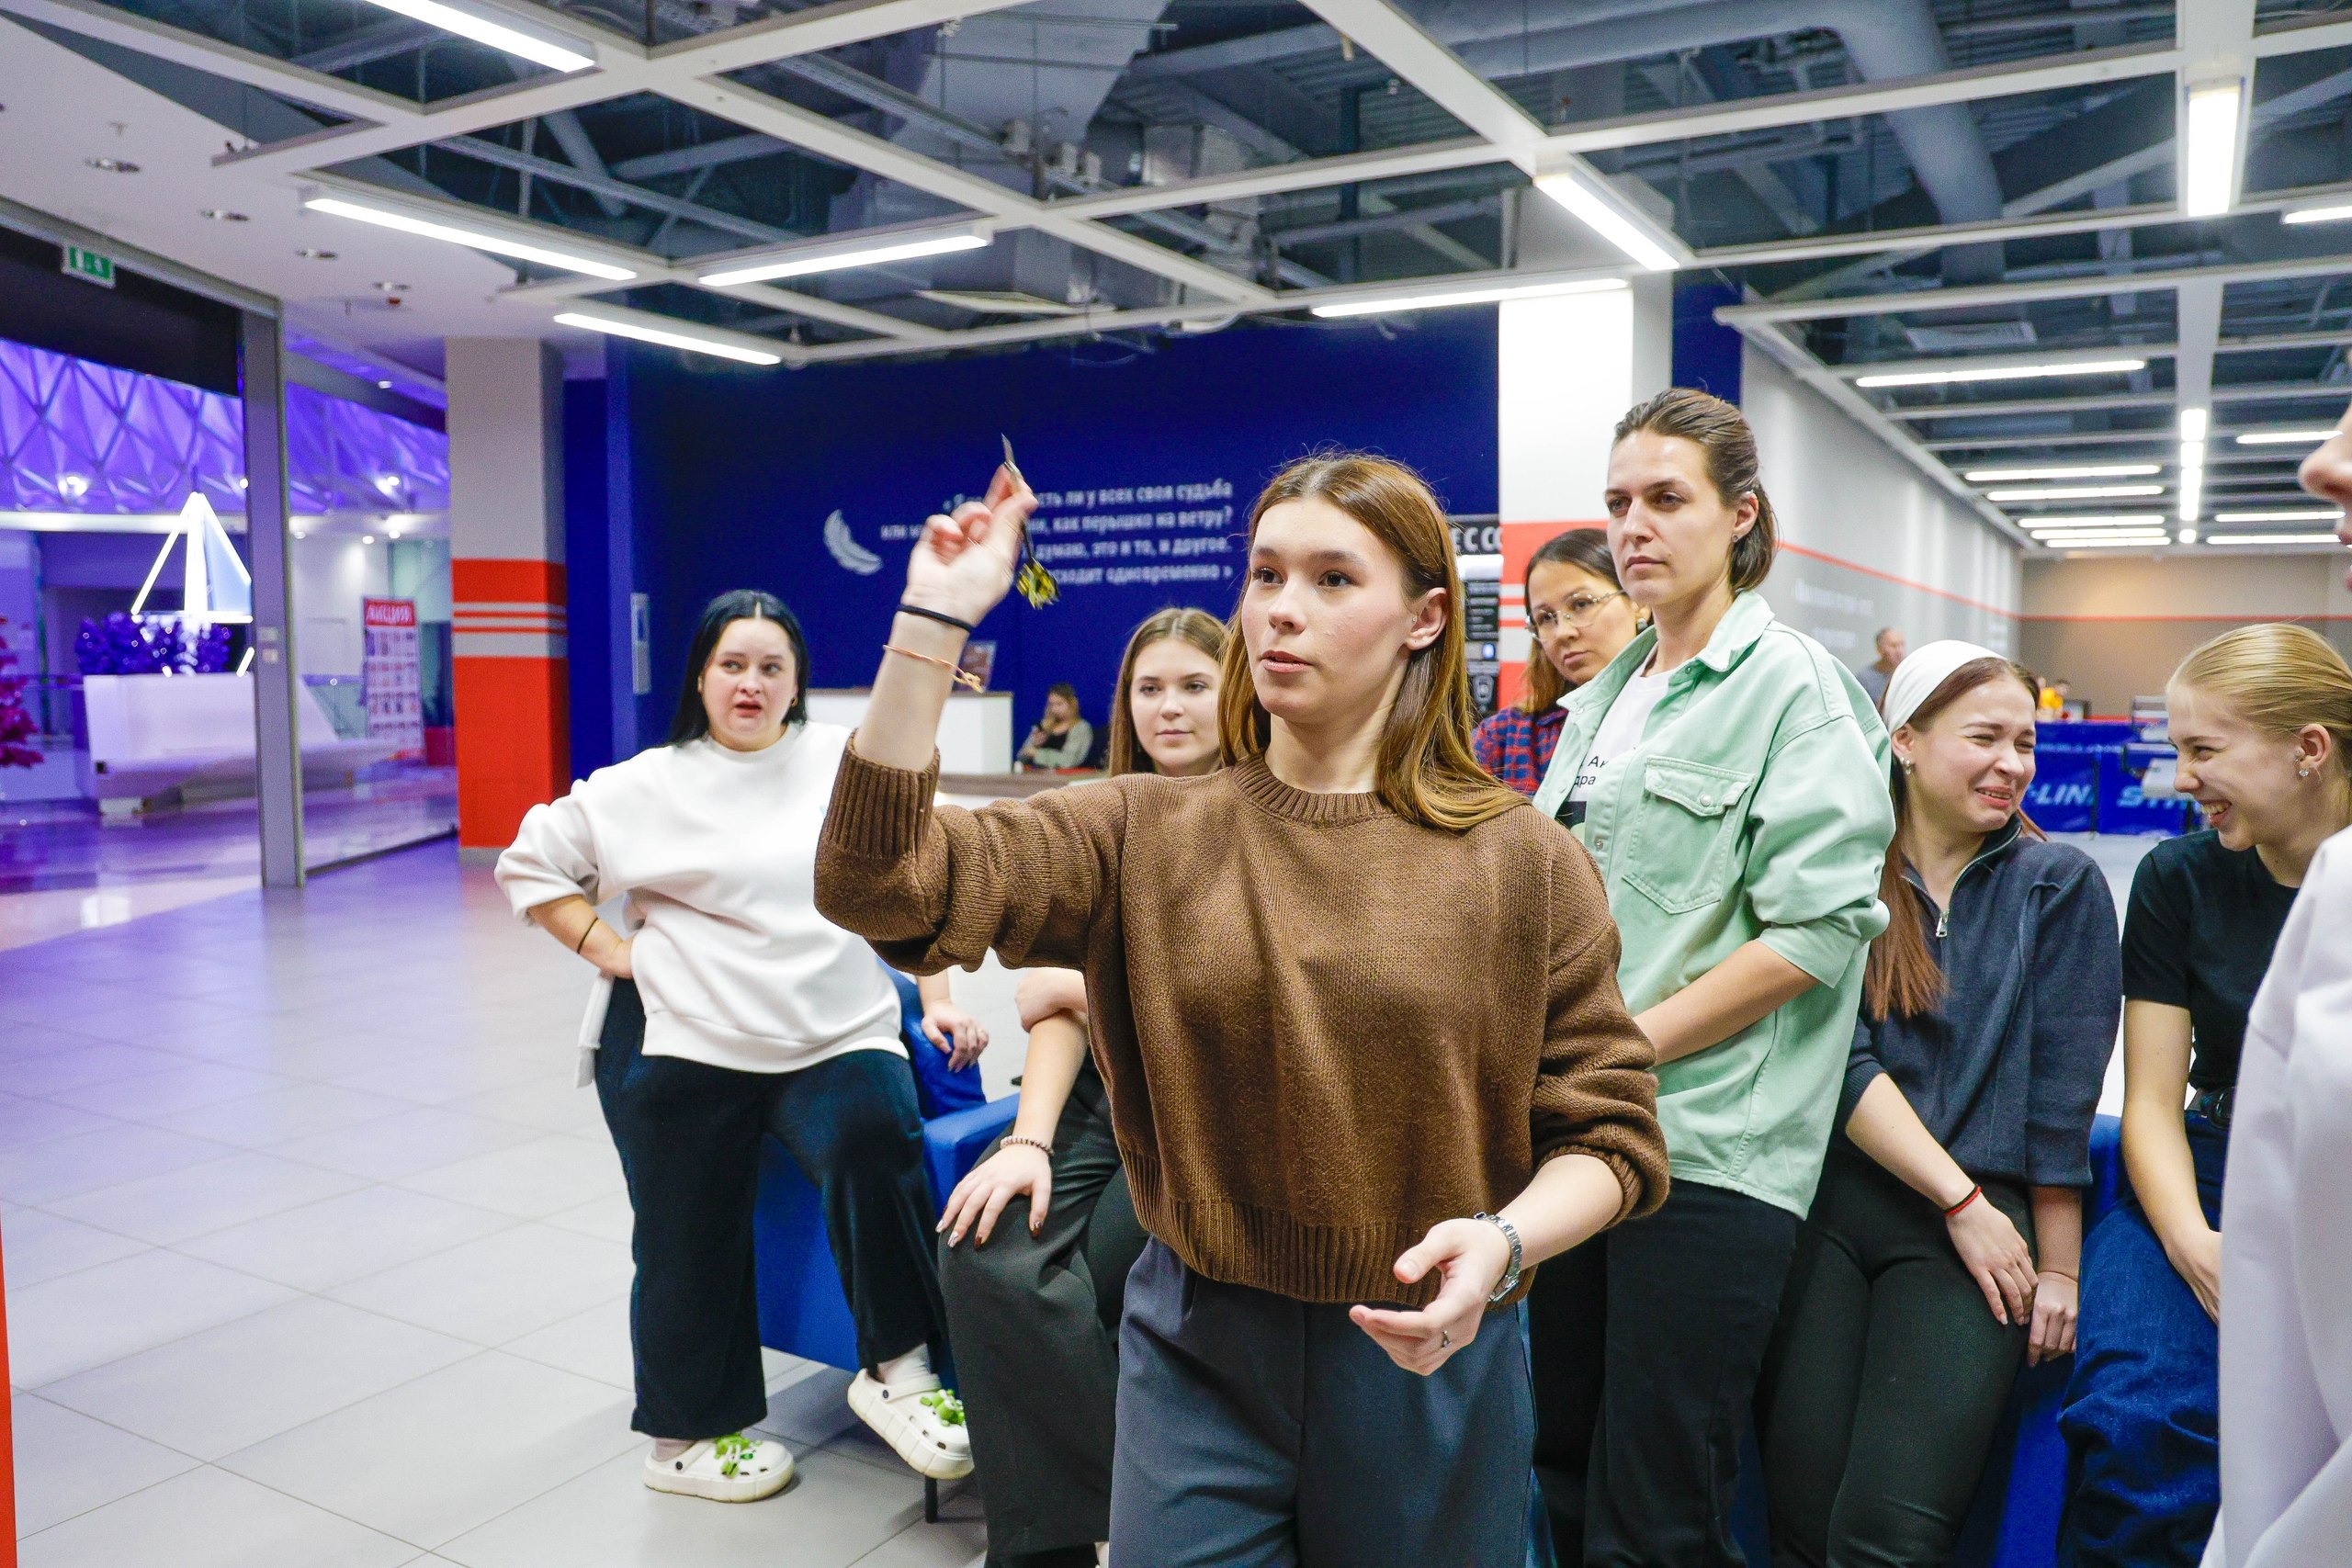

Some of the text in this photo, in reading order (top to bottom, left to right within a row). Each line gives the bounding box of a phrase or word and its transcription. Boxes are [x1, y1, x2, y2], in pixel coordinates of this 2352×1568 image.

[1035, 491, 1063, 508] сть
[1136, 485, 1174, 503] своя
[1175, 478, 1233, 503] судьба
[1178, 504, 1234, 530] ветру?
